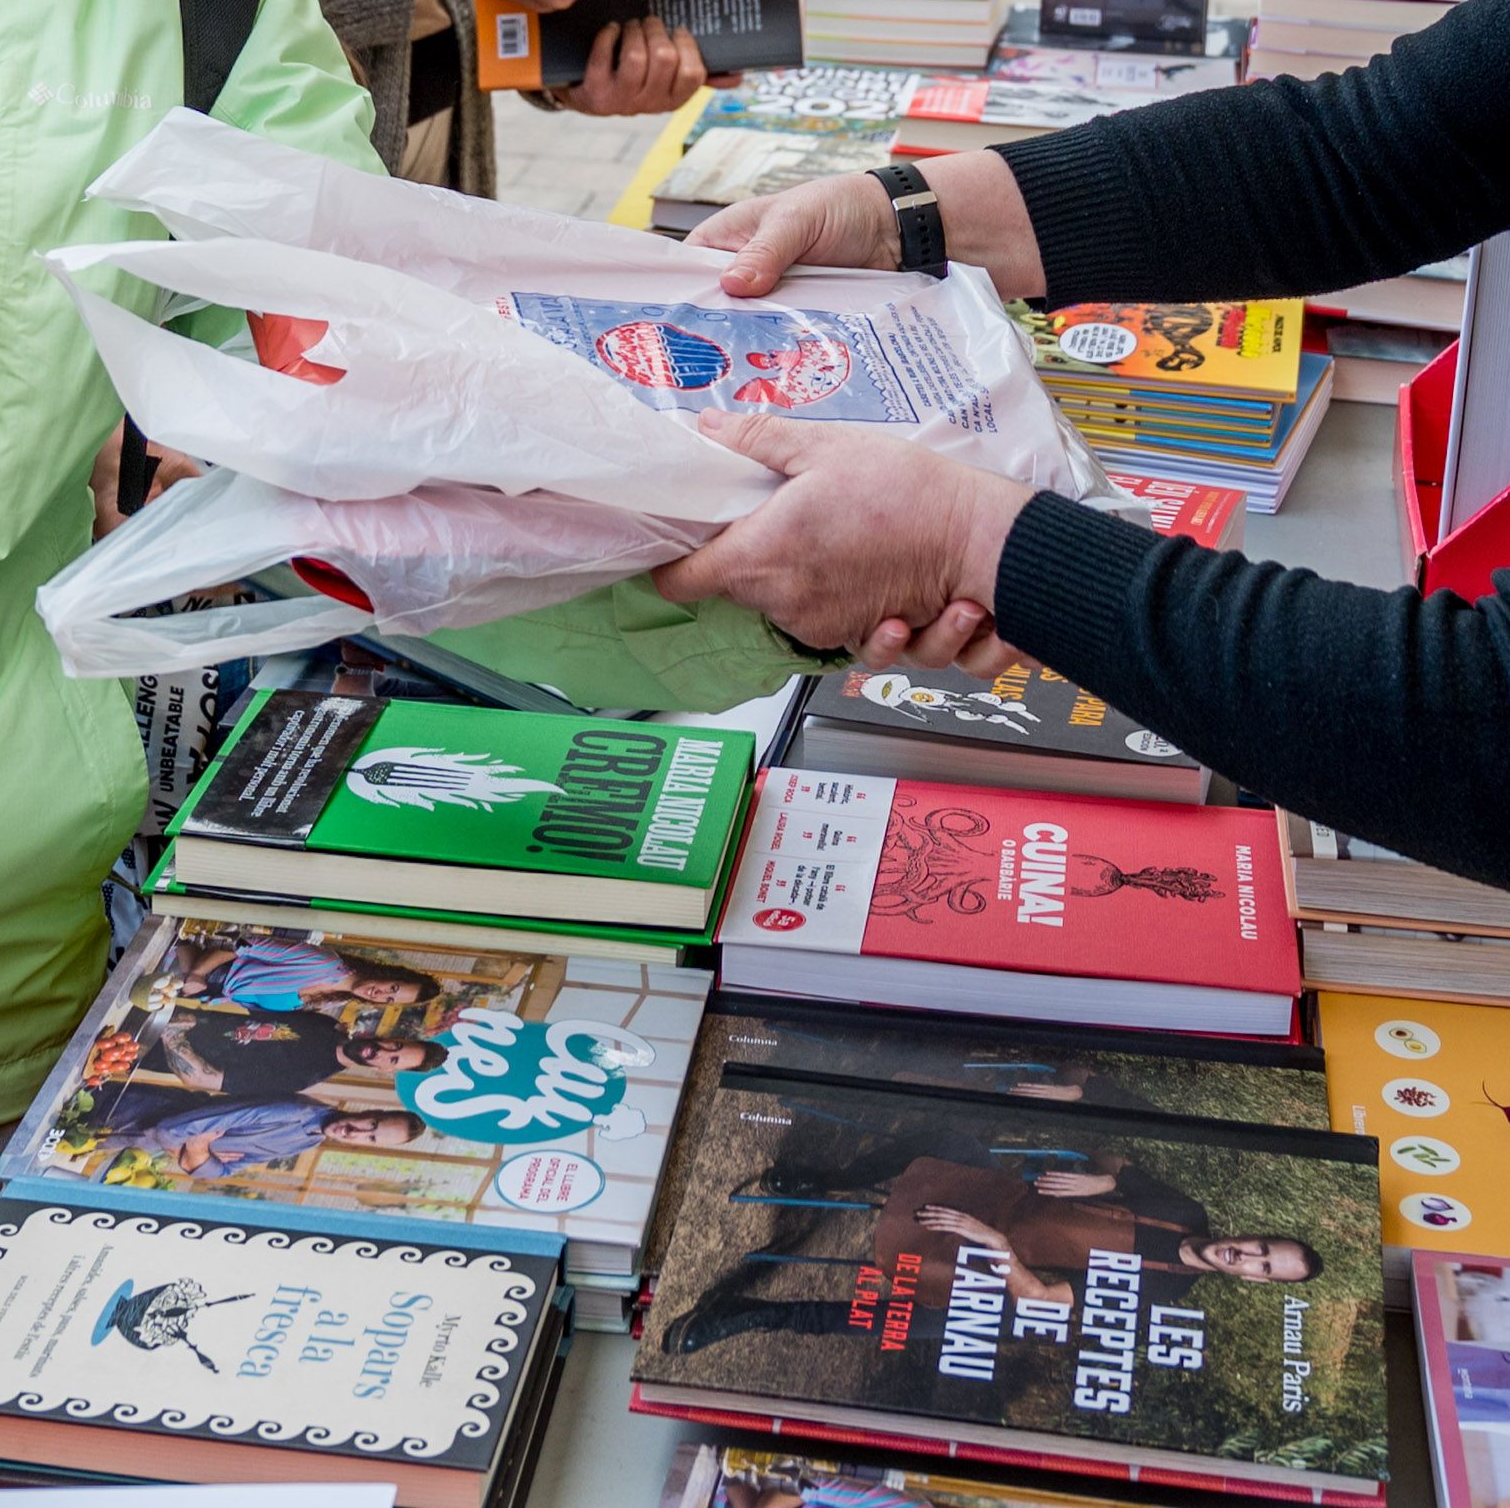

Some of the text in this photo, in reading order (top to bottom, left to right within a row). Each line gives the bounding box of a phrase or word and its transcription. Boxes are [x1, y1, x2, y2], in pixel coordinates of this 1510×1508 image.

[57, 82, 152, 109] Columbia
[159, 685, 185, 793] UNBEATABLE
[1068, 695, 1108, 727] PARA
[526, 730, 667, 864] CREMO!
[637, 737, 724, 872] MARIA NICOLAU
[777, 812, 789, 832] LAURA
[761, 860, 776, 883] MIQUEL
[1016, 821, 1069, 928] CUINA!
[1233, 844, 1259, 942] MARIA NICOLAU
[728, 1033, 778, 1048] Columna
[739, 1110, 792, 1126] Columna
[519, 1156, 542, 1200] PROGRAMA
[536, 1157, 562, 1204] OFICIAL DEL
[556, 1162, 579, 1202] EL LLIBRE
[848, 1265, 883, 1331] AL PLAT
[880, 1252, 923, 1352] DE LA TERRA
[937, 1245, 1012, 1383] L'ARNAU
[1012, 1297, 1071, 1344] DE
[1282, 1293, 1312, 1355] Arnau
[236, 1283, 323, 1380] fresca
[298, 1309, 356, 1364] a la
[351, 1290, 434, 1401] Sopars
[1073, 1247, 1143, 1416] RECEPTES
[1147, 1304, 1205, 1371] LES
